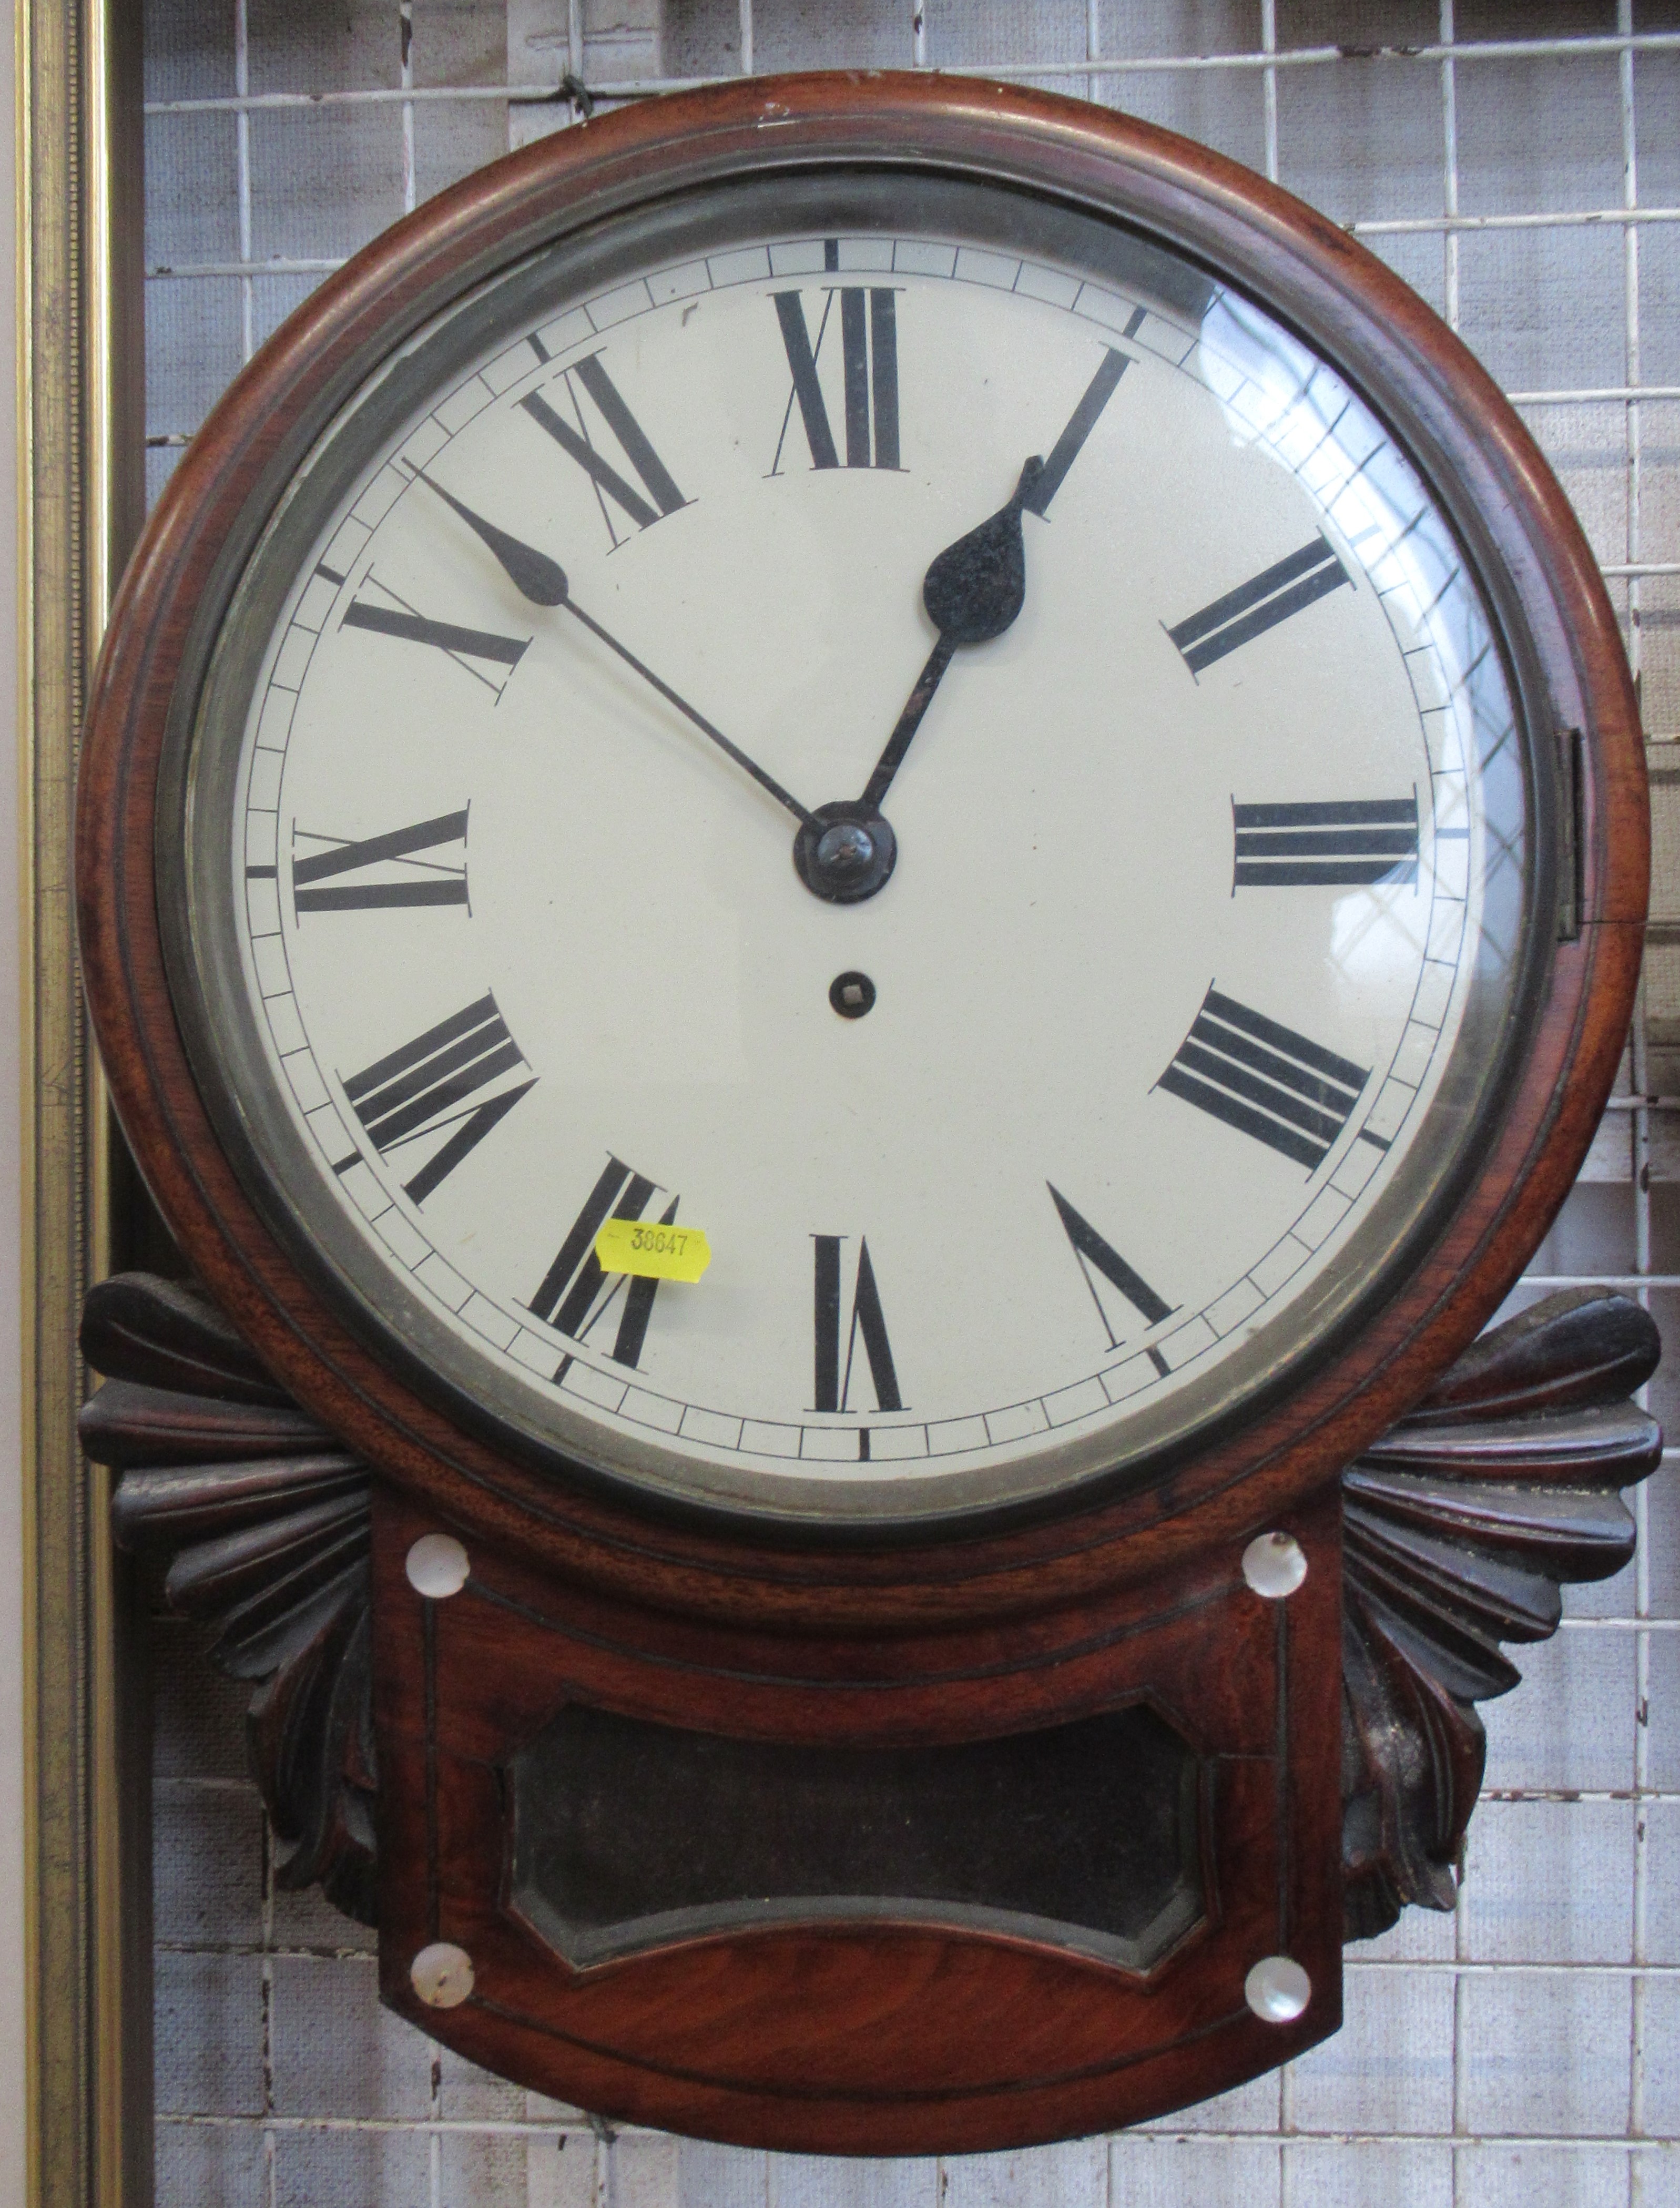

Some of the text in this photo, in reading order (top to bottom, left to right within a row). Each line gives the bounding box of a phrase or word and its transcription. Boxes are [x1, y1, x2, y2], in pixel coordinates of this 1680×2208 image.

[511, 347, 699, 555] XI
[761, 286, 910, 478] XII
[1023, 340, 1140, 524] I
[338, 562, 534, 706] X
[1159, 525, 1357, 686] II
[292, 798, 472, 929] IX
[1230, 782, 1419, 898] III
[334, 988, 541, 1213] VIII
[1148, 978, 1374, 1182] IIII
[630, 1228, 688, 1256] 38647
[803, 1234, 912, 1413] VI
[1046, 1180, 1184, 1353] V
